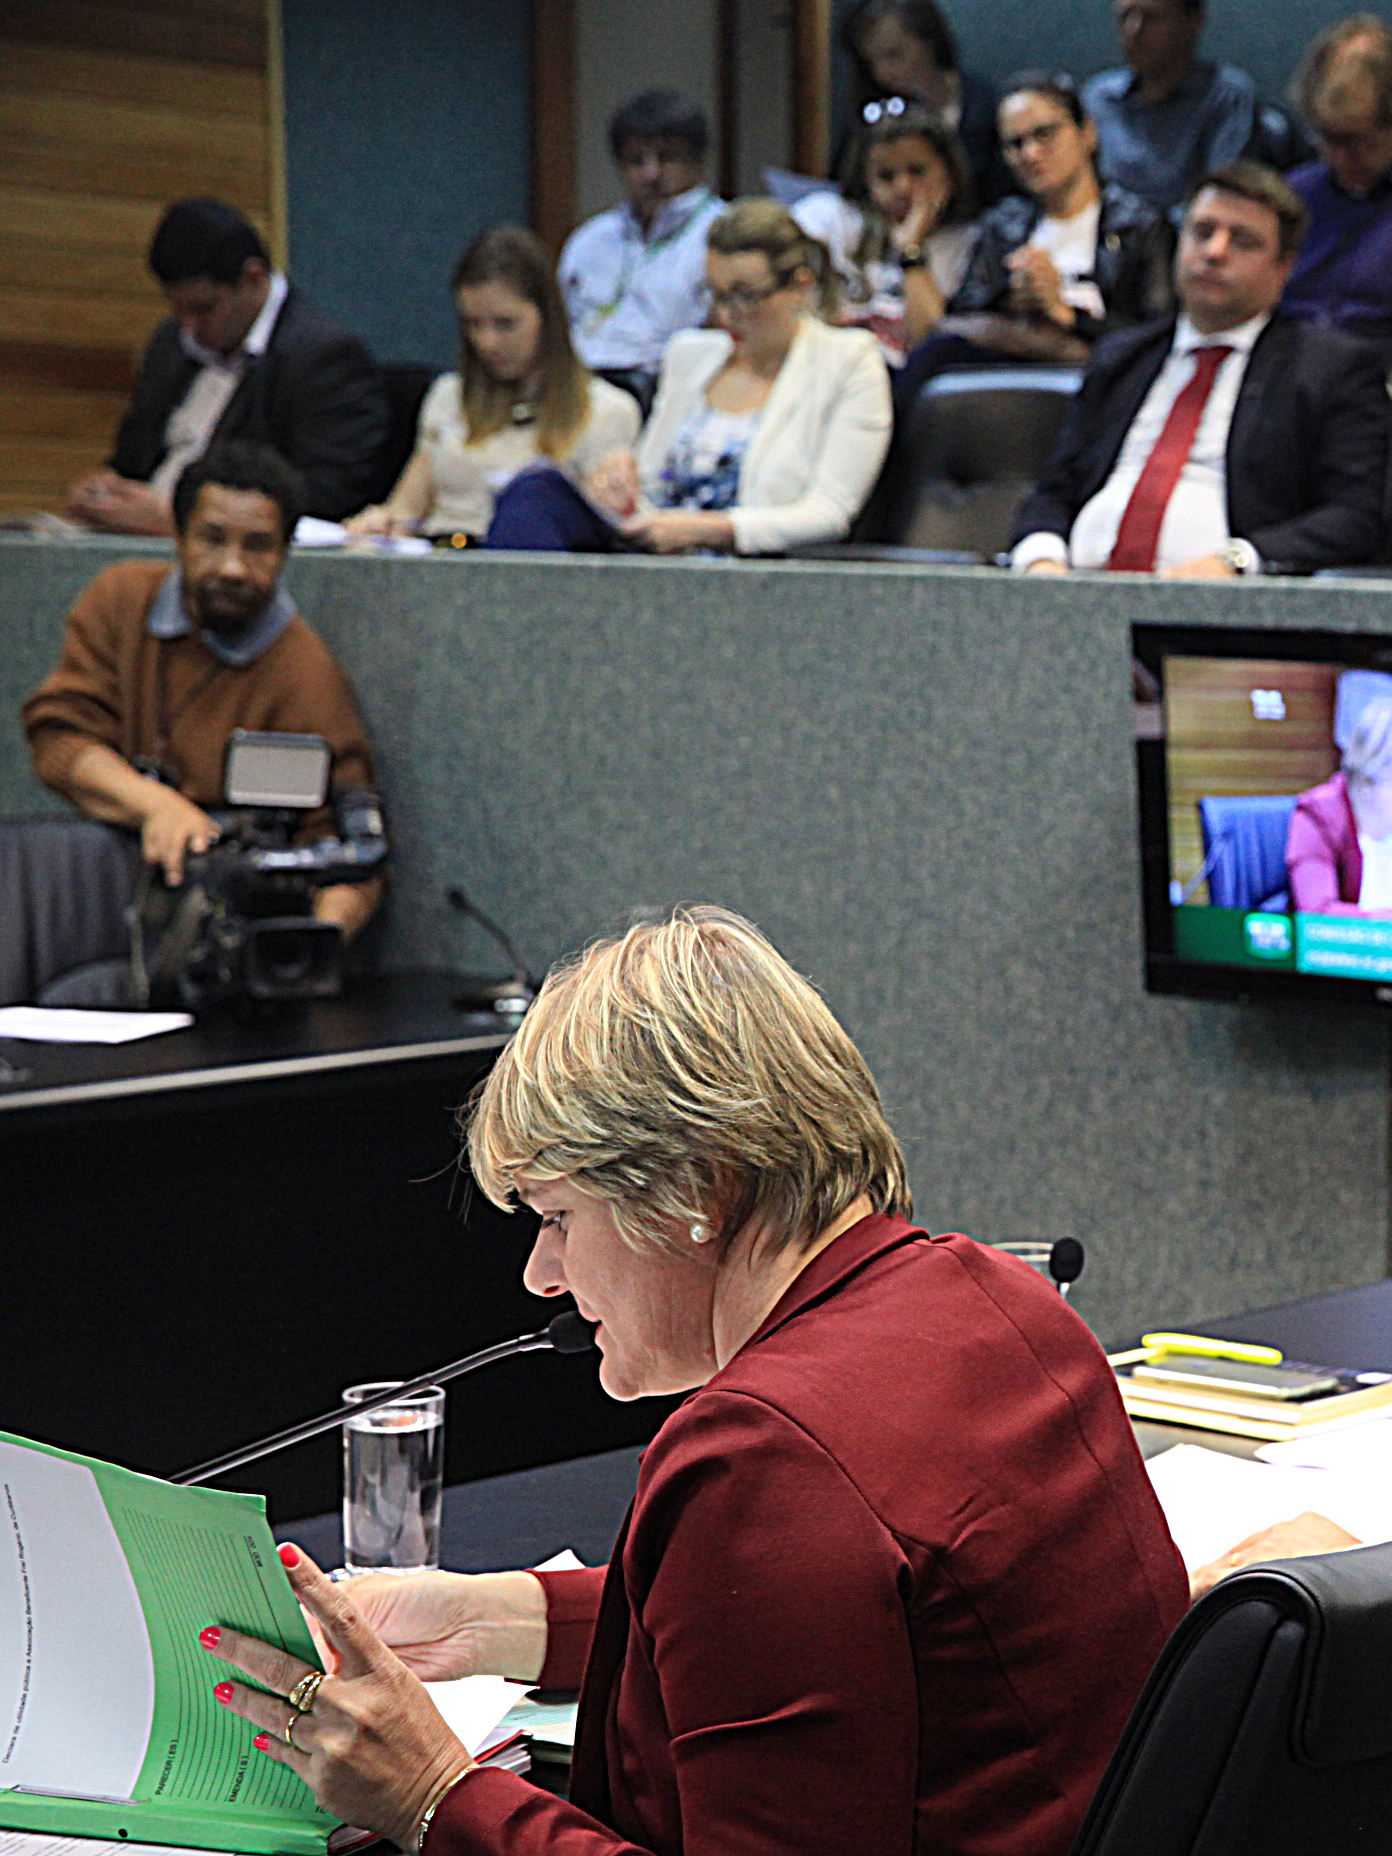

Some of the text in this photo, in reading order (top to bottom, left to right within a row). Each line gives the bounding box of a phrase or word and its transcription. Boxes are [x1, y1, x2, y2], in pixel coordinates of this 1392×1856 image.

[25, 1617, 34, 1657] Associação
[23, 1665, 31, 1692] pública
[17, 1693, 27, 1723] utilidade
[13, 1725, 20, 1735] de
[2, 1736, 17, 1763] Declara
